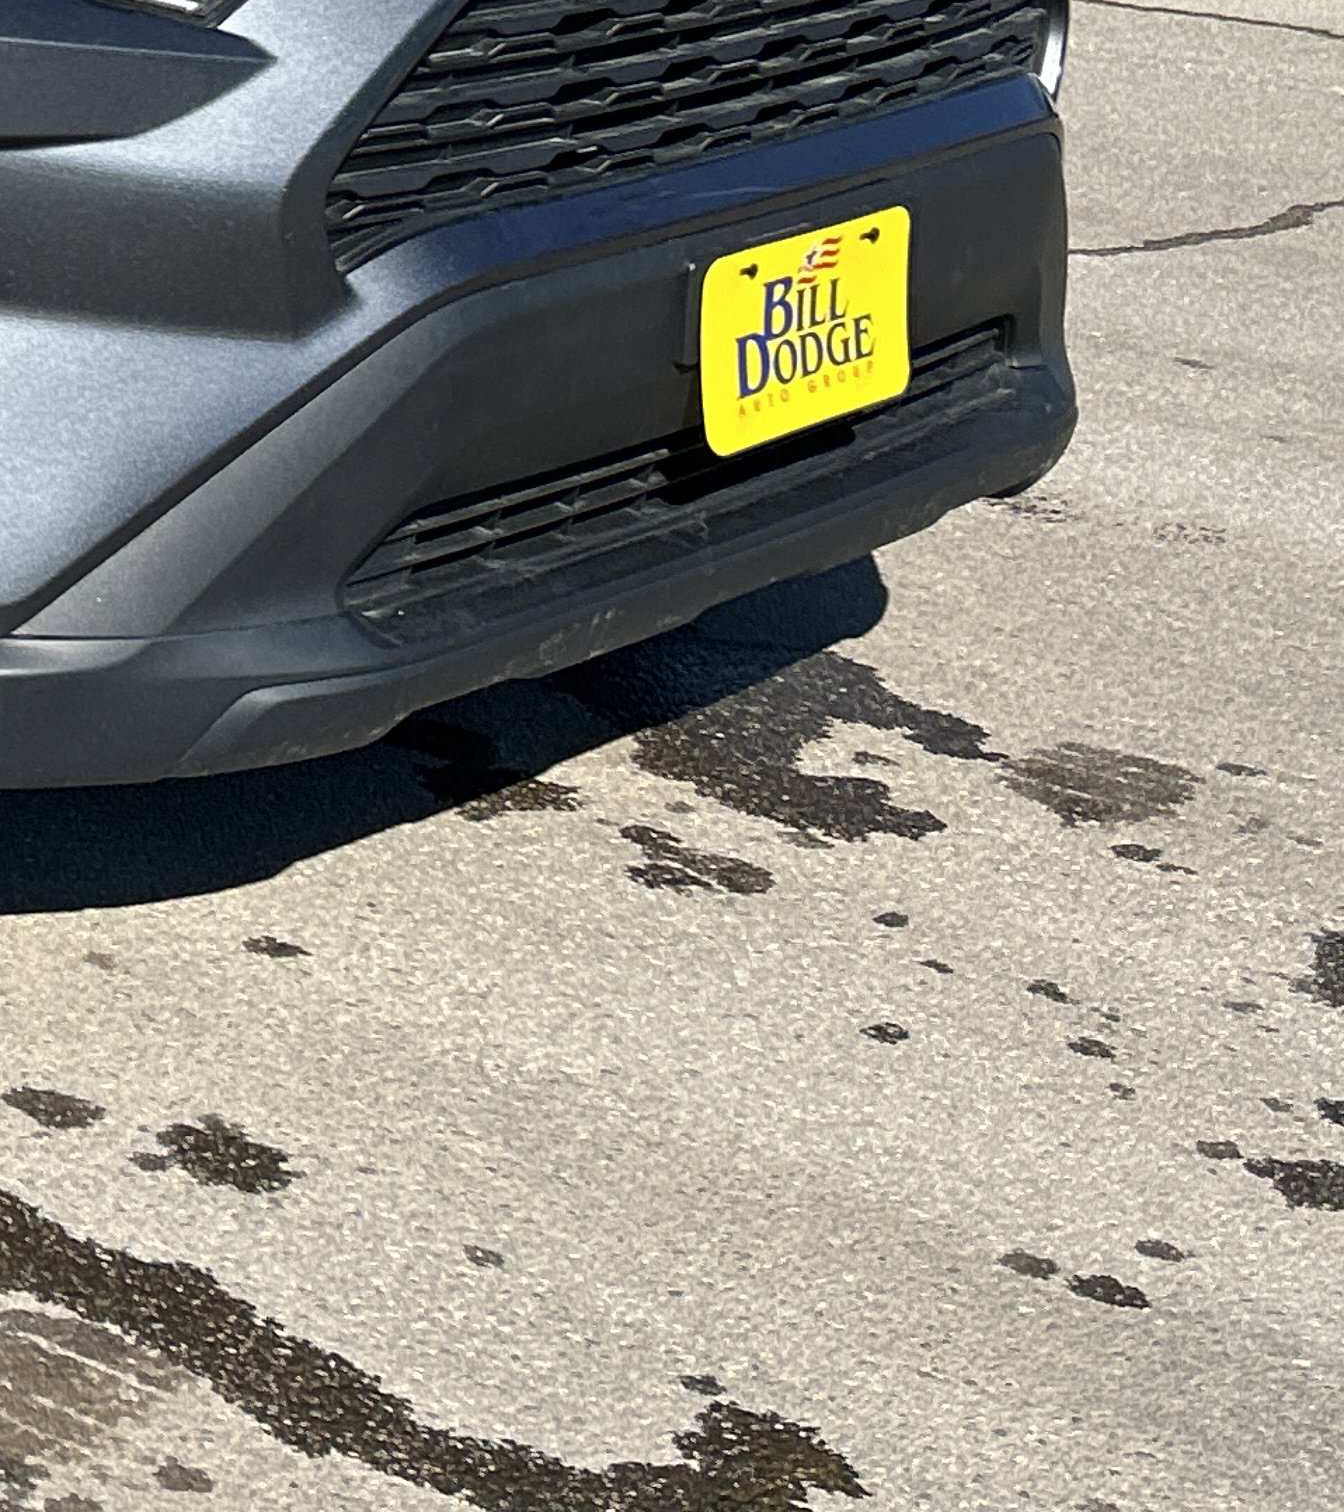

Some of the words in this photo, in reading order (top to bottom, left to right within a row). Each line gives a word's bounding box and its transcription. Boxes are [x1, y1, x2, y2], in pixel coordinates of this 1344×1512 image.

[763, 276, 849, 341] BILL
[735, 314, 875, 400] DODGE
[737, 388, 790, 418] AUTO
[806, 359, 874, 394] GROUP
